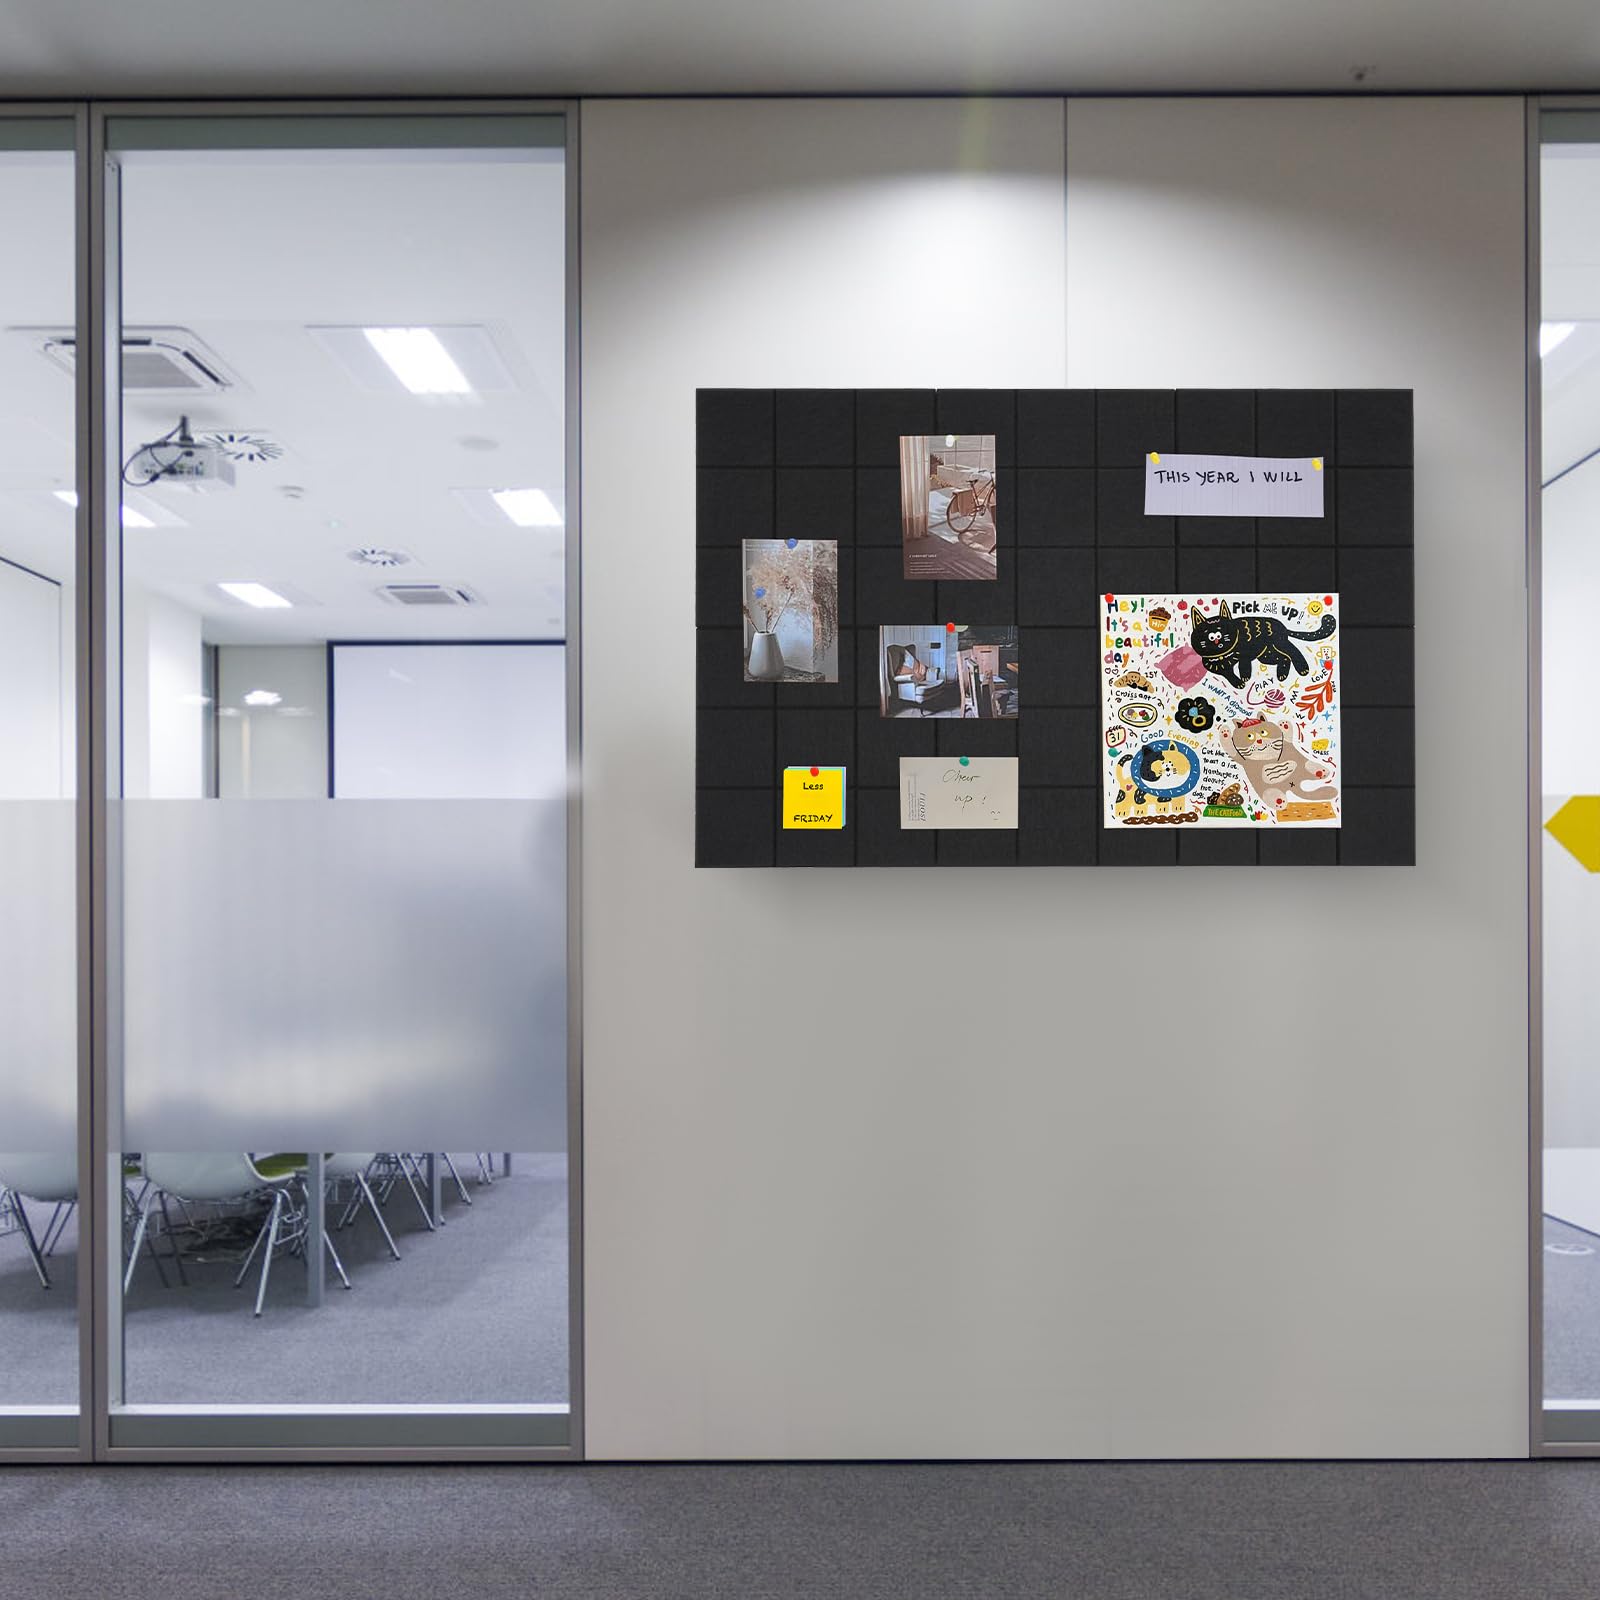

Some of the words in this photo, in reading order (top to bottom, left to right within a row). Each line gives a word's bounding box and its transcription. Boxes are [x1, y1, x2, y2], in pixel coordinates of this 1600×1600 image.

[1154, 470, 1190, 484] THIS
[1196, 471, 1239, 485] YEAR
[1250, 471, 1254, 483] I
[1264, 471, 1302, 482] WILL
[1107, 598, 1145, 614] Hey!
[1233, 601, 1260, 614] Pick
[1263, 602, 1278, 614] ME
[1106, 616, 1129, 632] It's
[1132, 622, 1142, 631] a
[1105, 632, 1174, 648] beautiful
[1104, 650, 1134, 668] day.
[1311, 668, 1328, 682] LOVE
[1202, 678, 1208, 686] I
[1208, 684, 1226, 697] WANT
[1109, 732, 1120, 743] 31
[1168, 730, 1200, 749] Evening
[803, 782, 823, 790] Less
[794, 815, 833, 823] FRIDAY
